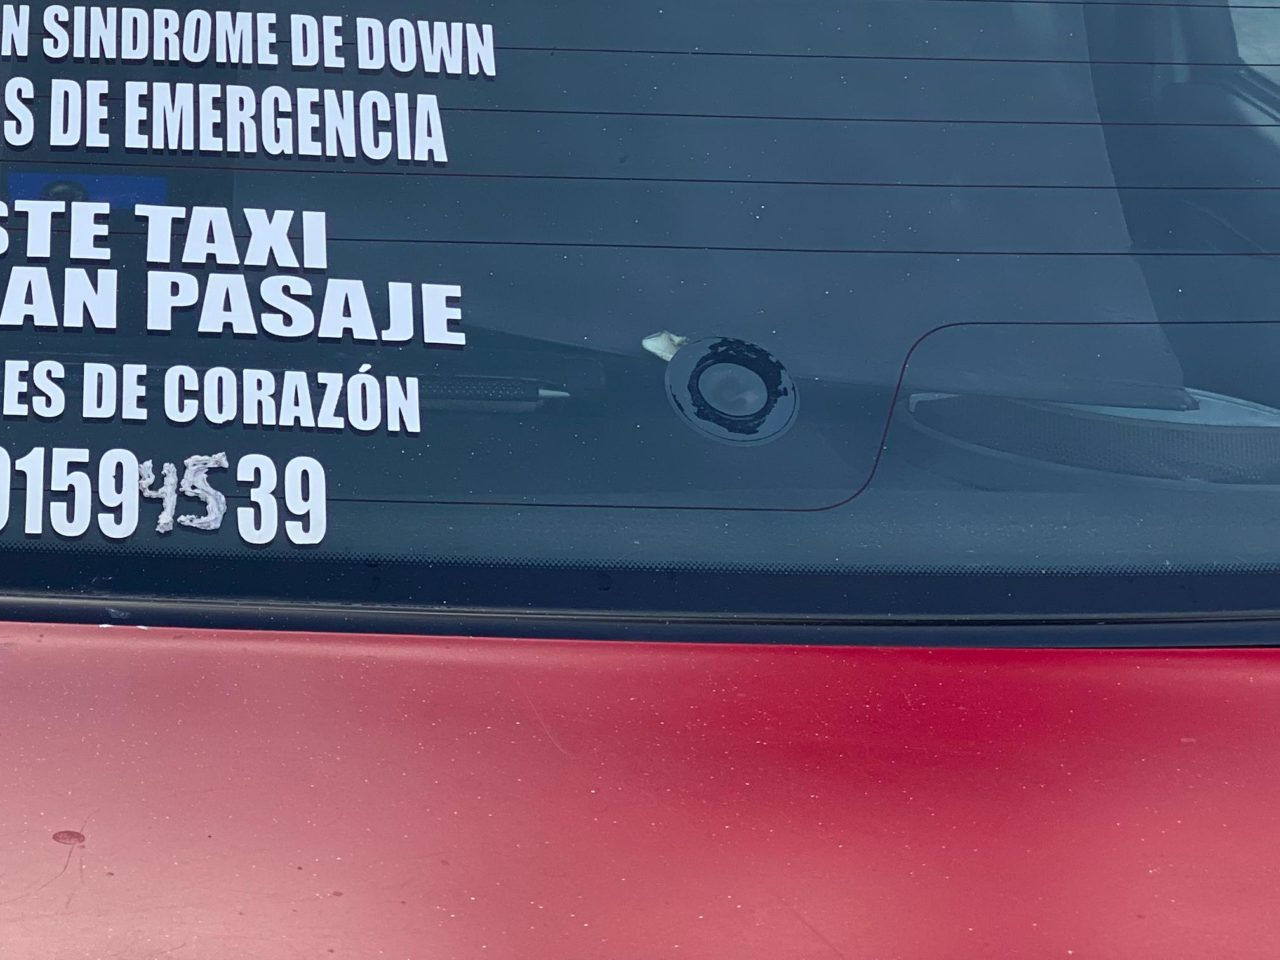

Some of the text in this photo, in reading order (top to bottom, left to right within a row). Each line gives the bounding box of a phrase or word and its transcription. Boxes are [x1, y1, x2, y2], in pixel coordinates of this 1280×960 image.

[42, 4, 279, 65] SINDROME
[290, 13, 348, 68] DE
[356, 17, 497, 76] DOWN
[49, 78, 110, 148] DE
[124, 80, 449, 163] EMERGENCIA
[134, 203, 328, 269] TAXI
[146, 270, 466, 345] PASAJE
[2, 359, 66, 418] ES
[82, 362, 148, 420] DE
[164, 363, 421, 433] CORAZÓN
